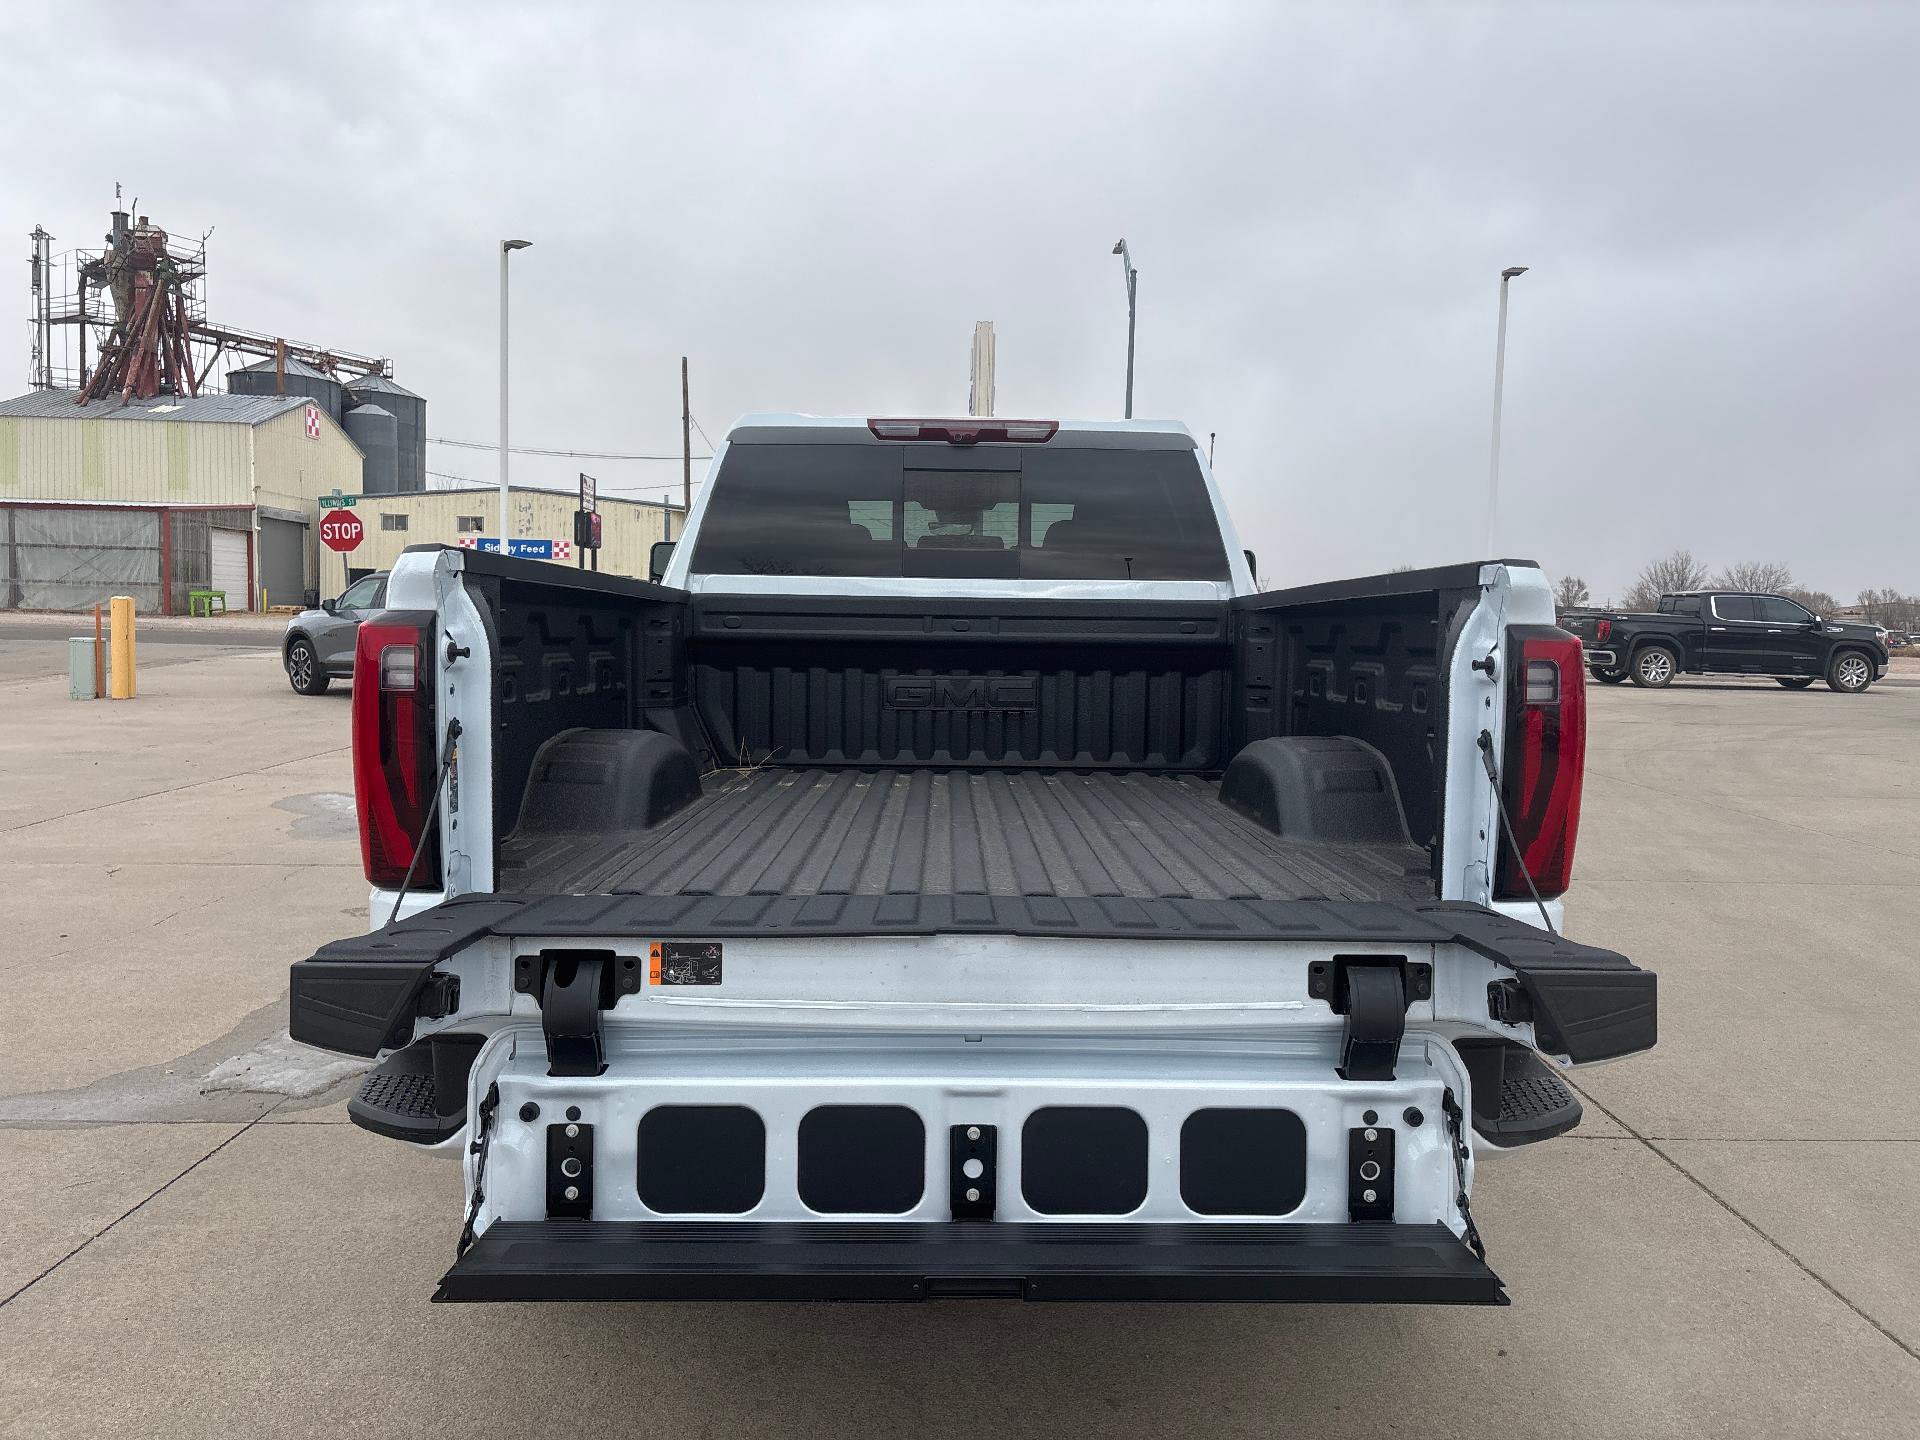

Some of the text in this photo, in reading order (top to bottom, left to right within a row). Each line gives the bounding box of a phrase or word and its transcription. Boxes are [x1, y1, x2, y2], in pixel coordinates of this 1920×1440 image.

[323, 522, 361, 540] STOP
[484, 542, 545, 554] Sidy Feed
[885, 678, 1035, 709] GMC
